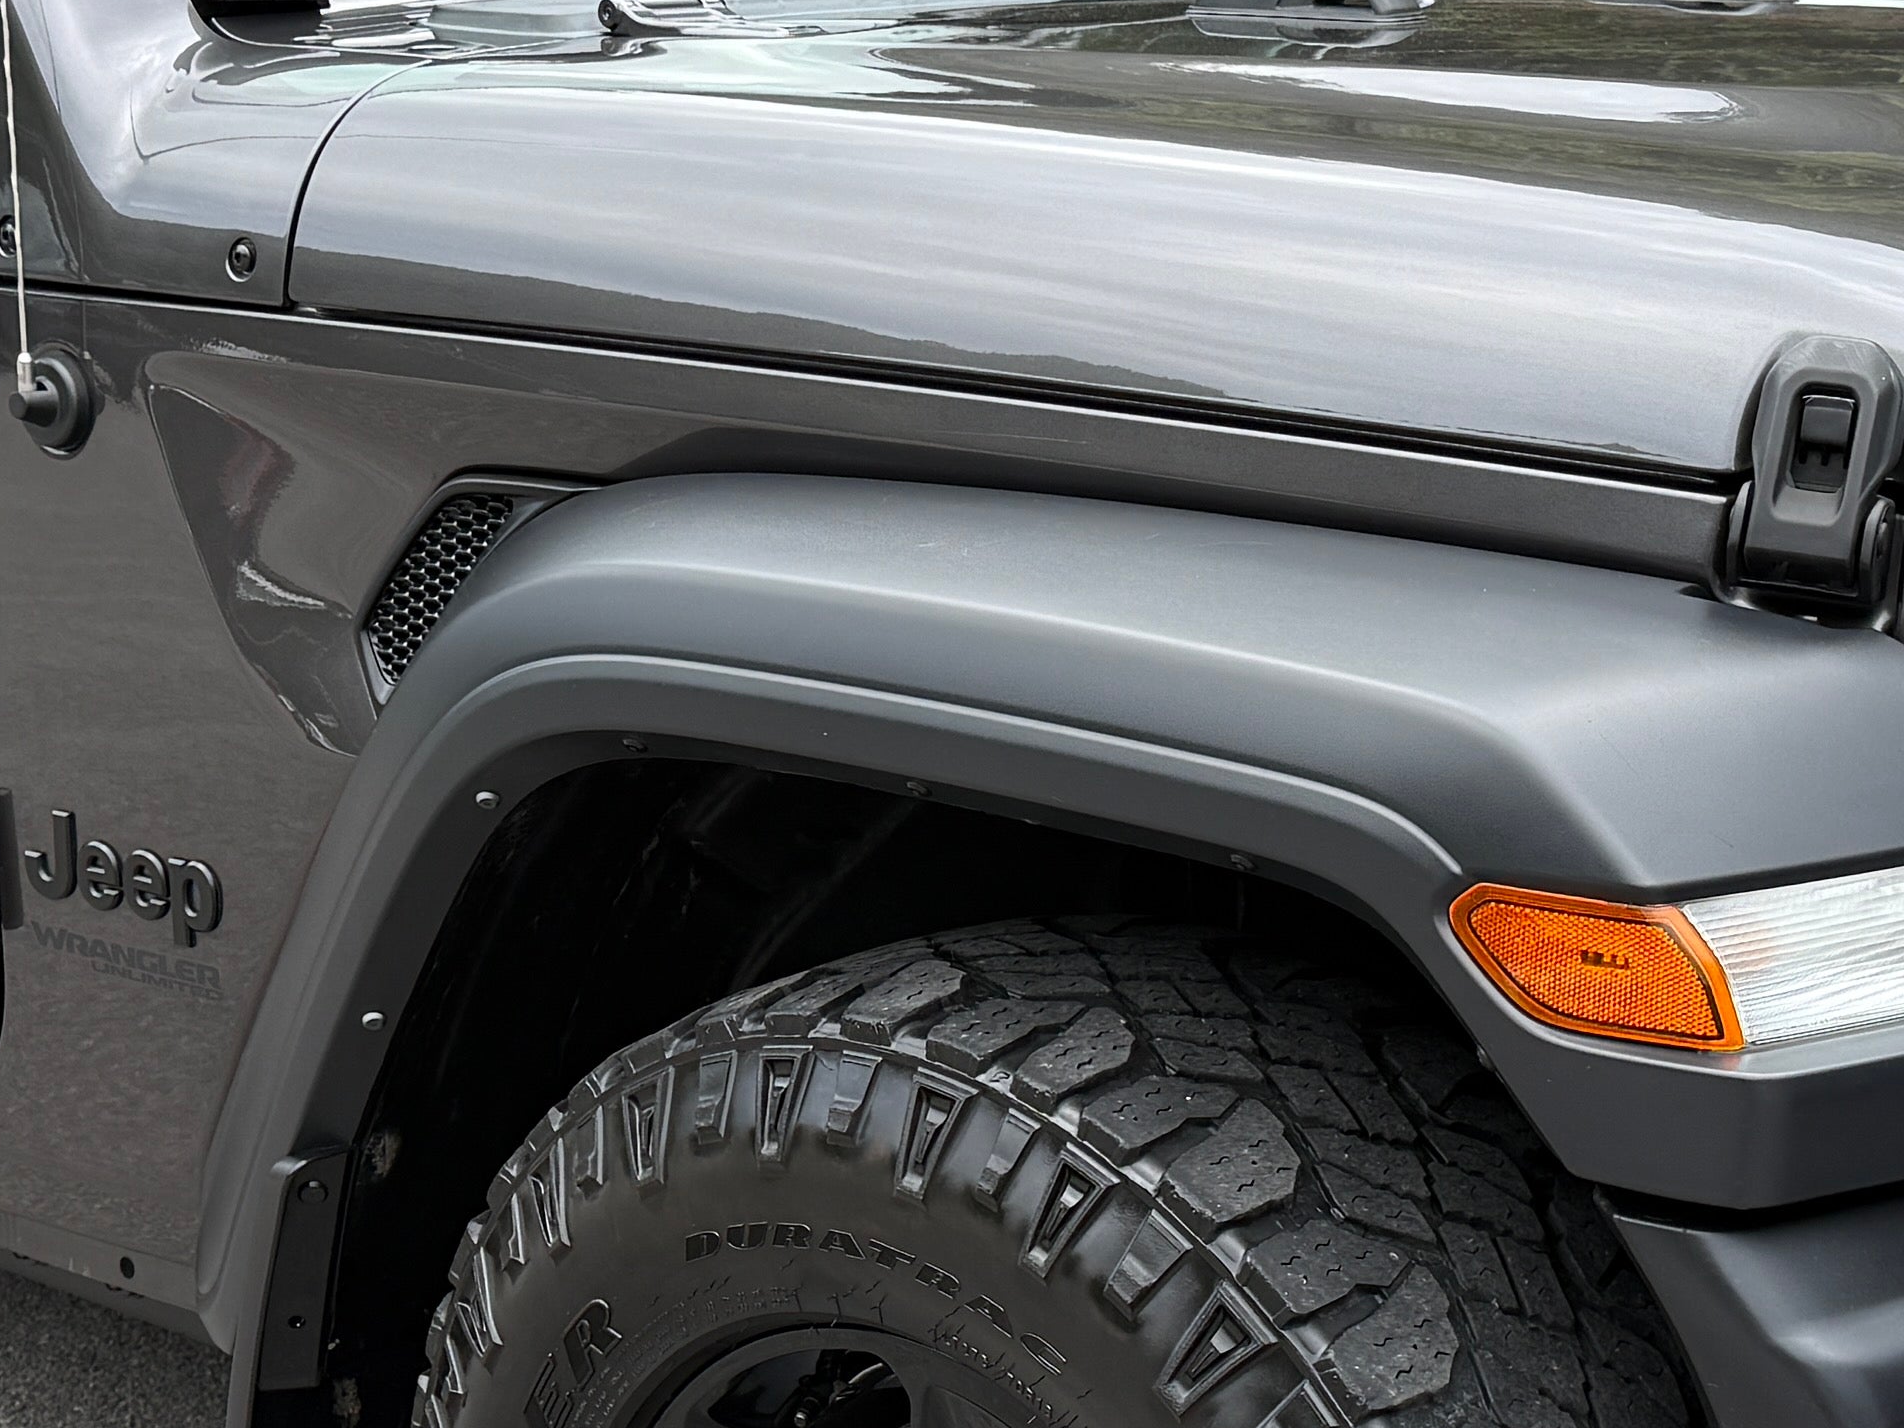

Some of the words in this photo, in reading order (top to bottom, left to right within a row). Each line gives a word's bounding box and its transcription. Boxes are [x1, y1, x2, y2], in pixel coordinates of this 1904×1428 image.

[24, 808, 224, 949] Jeep
[29, 920, 223, 989] WRANGLER
[684, 1221, 1069, 1375] DURATRAC
